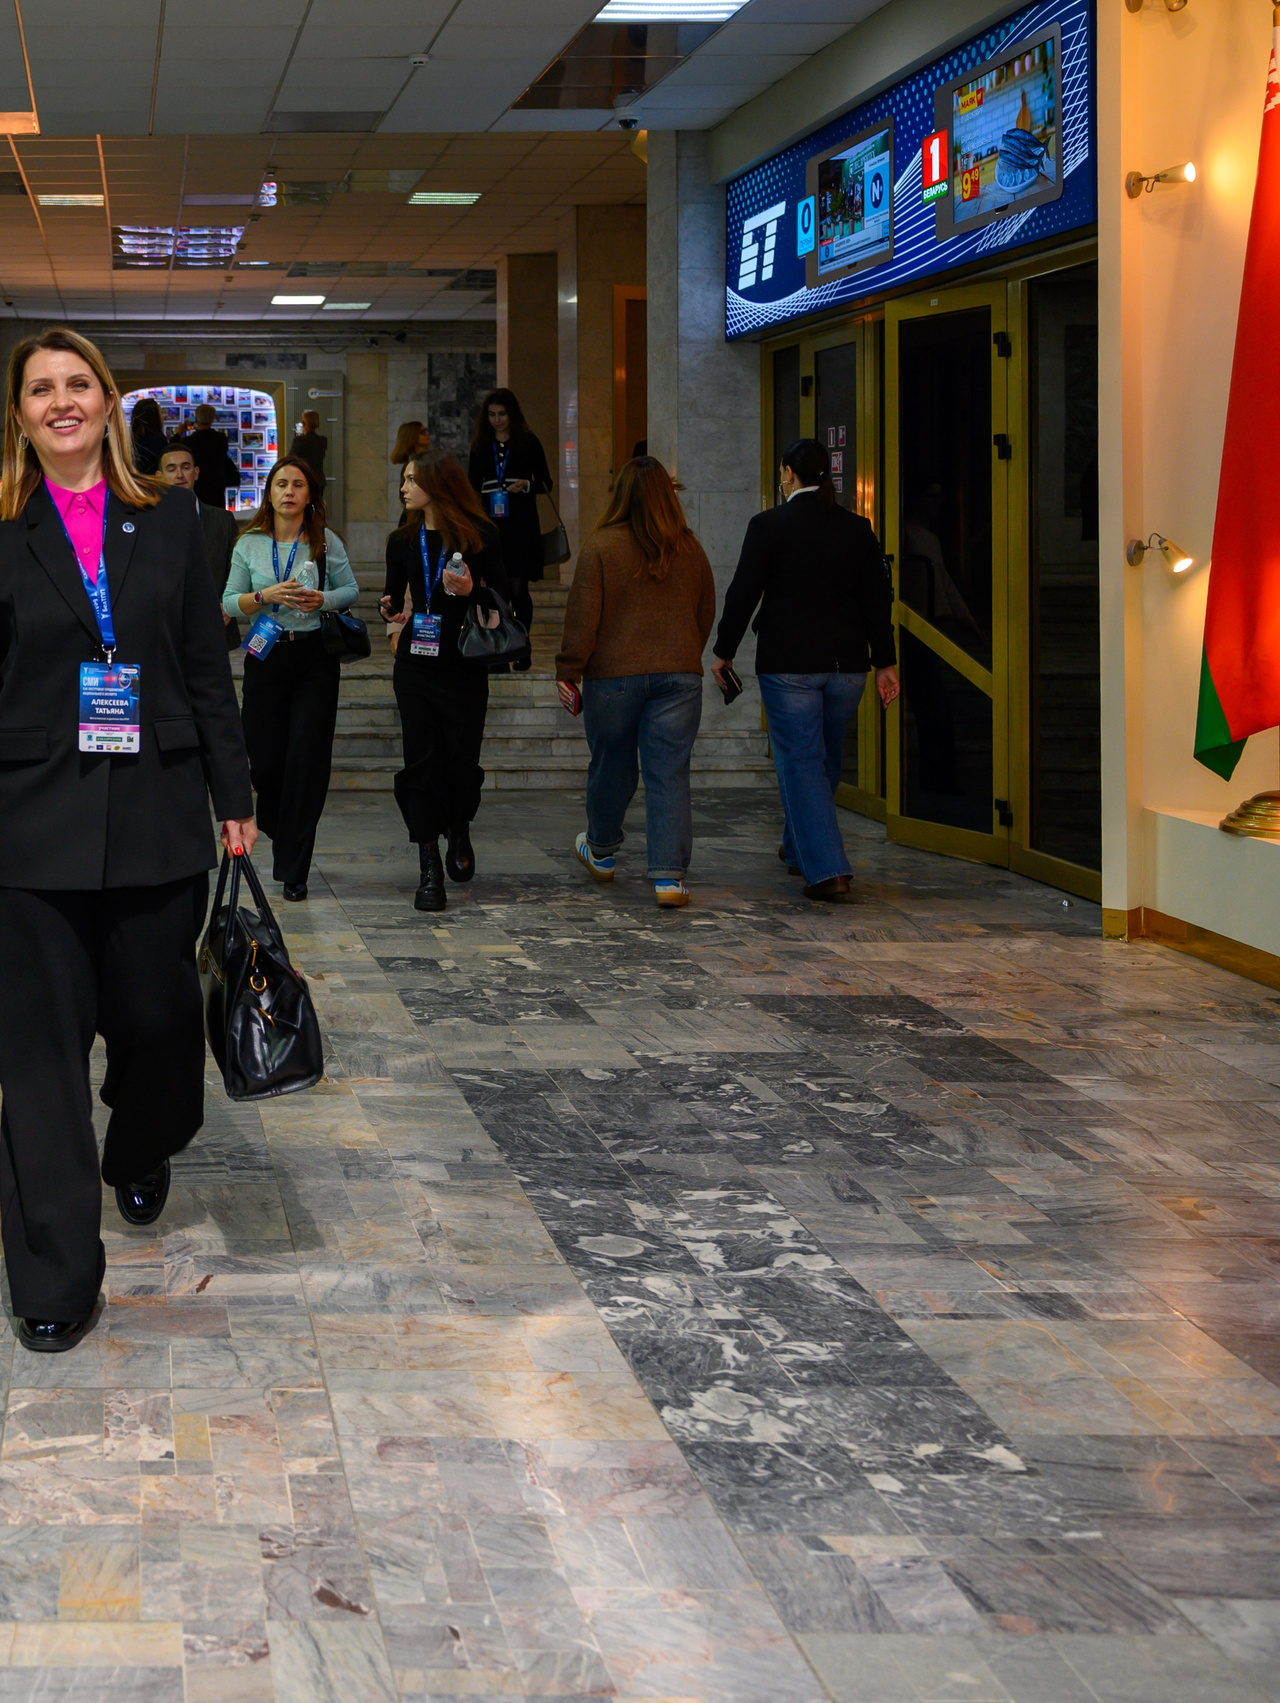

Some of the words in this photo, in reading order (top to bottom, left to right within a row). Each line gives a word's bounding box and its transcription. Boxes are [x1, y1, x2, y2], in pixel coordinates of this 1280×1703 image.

[930, 137, 939, 182] 1
[962, 172, 971, 199] 9
[970, 168, 979, 181] 49
[923, 183, 948, 200] БЕЛАРУСЬ
[82, 676, 99, 687] СМИ
[91, 698, 129, 707] АЛЕКСЕЕВА
[95, 707, 125, 716] ТАТЬЯНА
